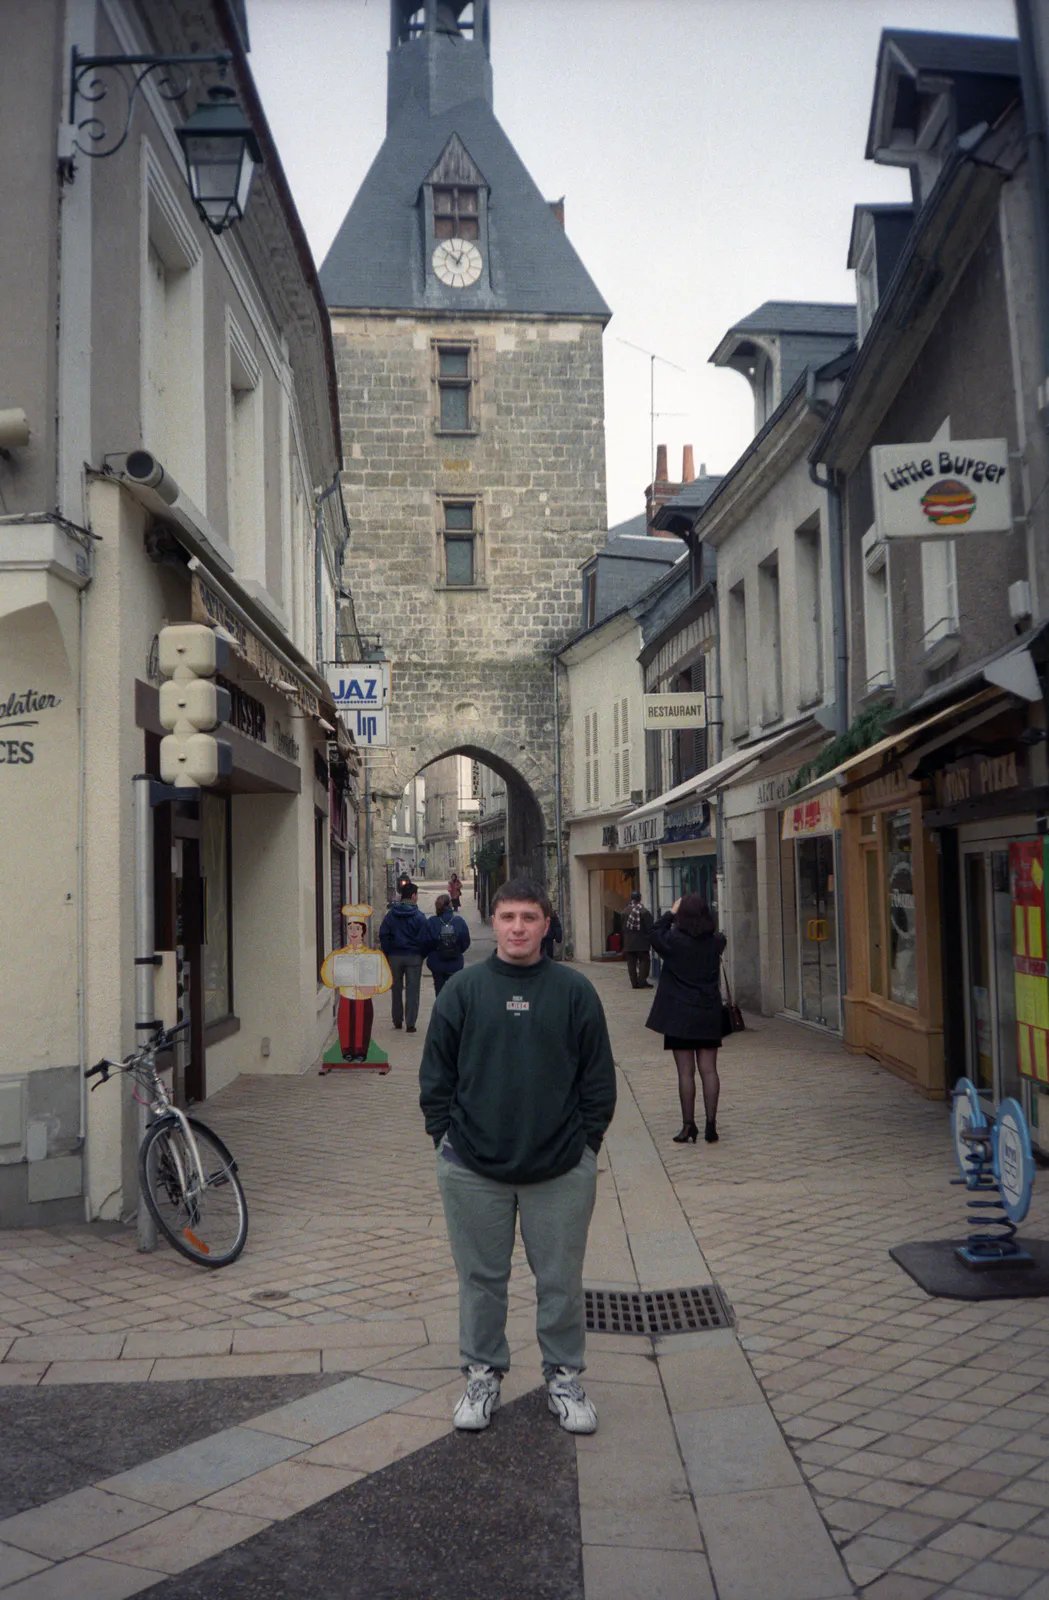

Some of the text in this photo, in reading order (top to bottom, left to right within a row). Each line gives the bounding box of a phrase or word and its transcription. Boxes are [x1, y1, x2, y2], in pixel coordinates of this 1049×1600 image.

[883, 452, 1006, 491] Little Burger
[331, 679, 377, 699] JAZ
[648, 705, 702, 718] RESTAURANT
[357, 710, 377, 743] lip
